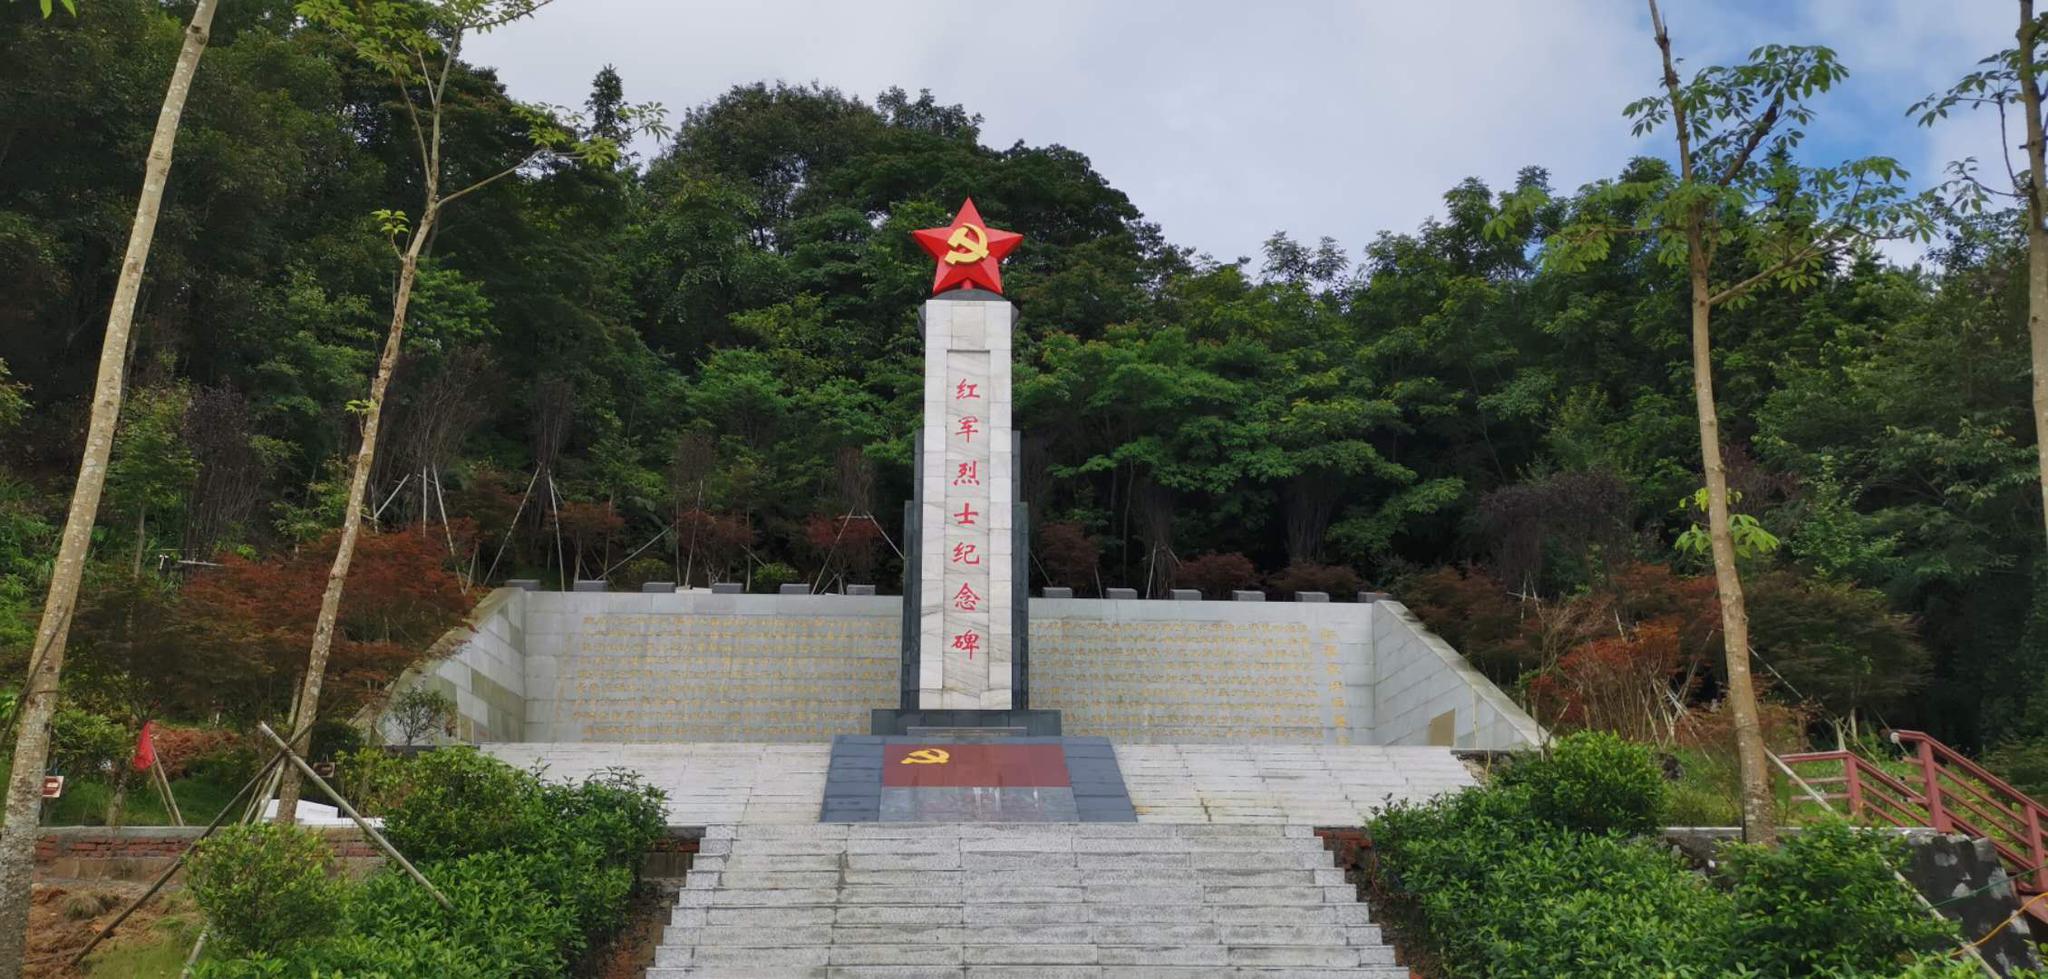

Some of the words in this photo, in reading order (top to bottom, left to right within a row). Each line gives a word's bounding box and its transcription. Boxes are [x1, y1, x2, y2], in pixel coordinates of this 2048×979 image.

[952, 379, 981, 660] 红军烈士纪念碑
